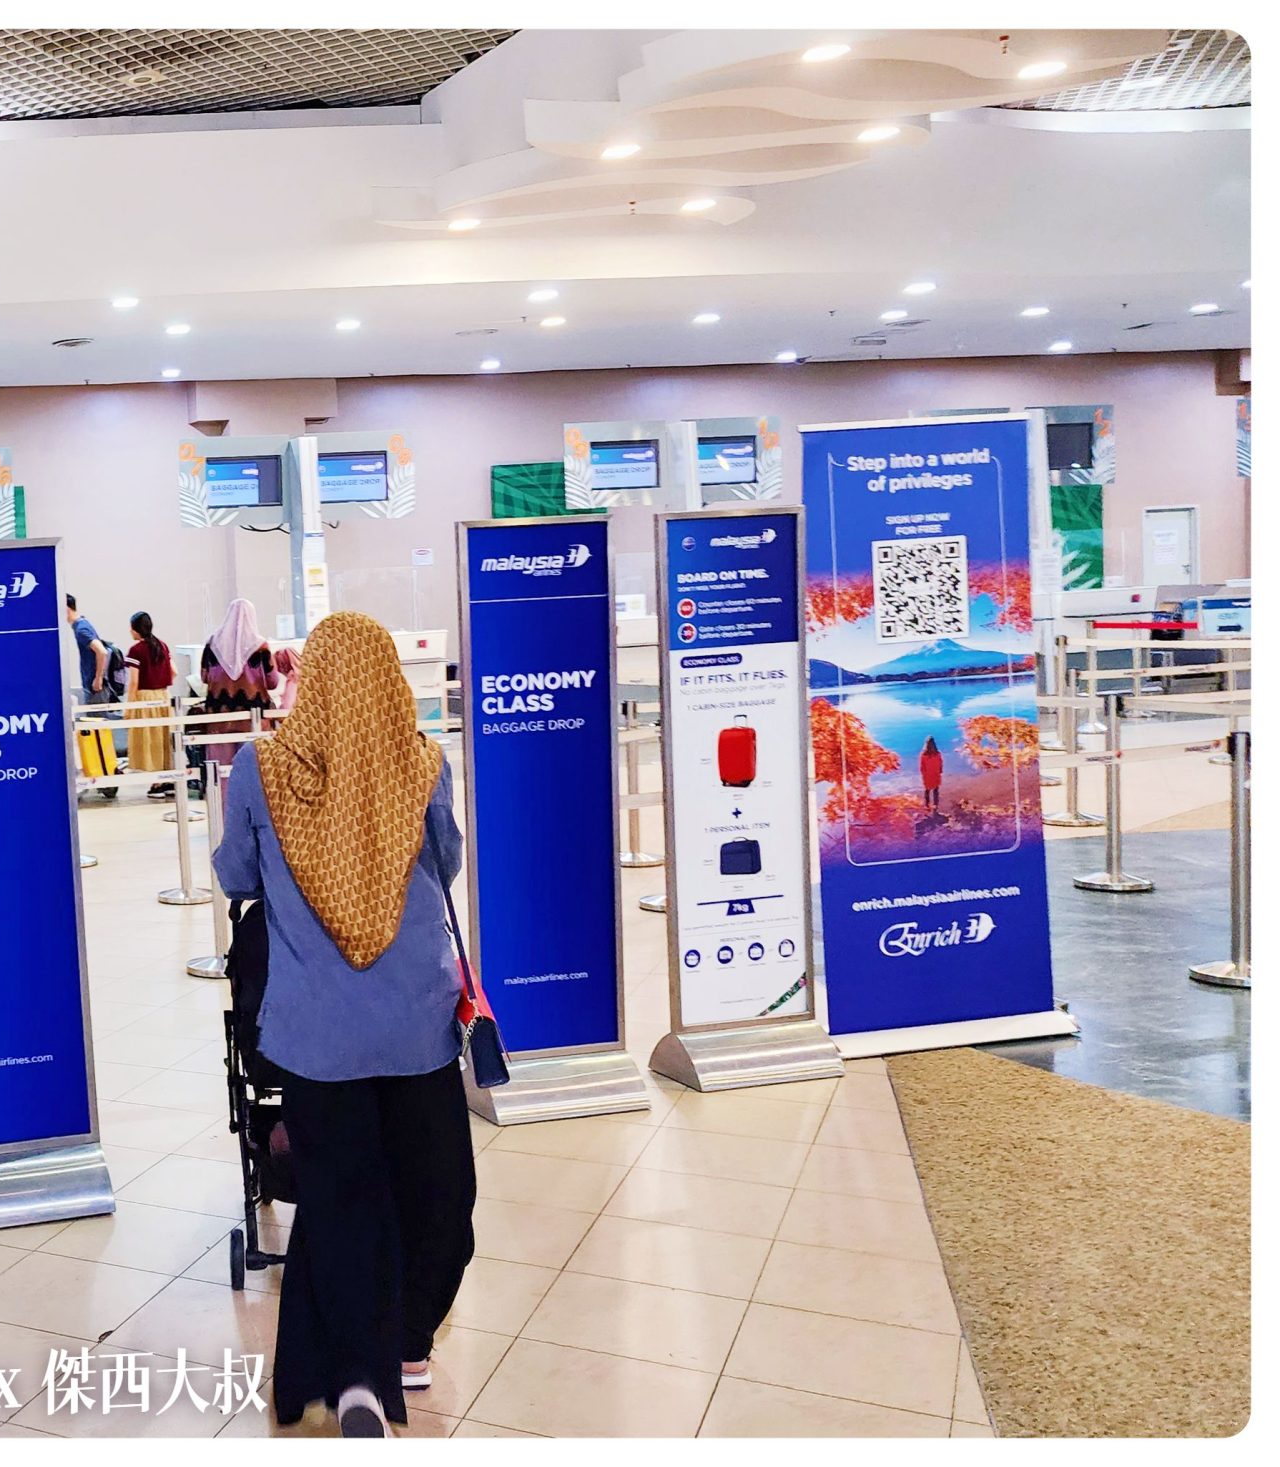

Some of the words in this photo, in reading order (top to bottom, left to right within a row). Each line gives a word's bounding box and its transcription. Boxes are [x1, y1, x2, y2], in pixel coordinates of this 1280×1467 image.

[847, 455, 887, 473] Step
[889, 453, 925, 470] into
[927, 455, 938, 467] a
[941, 448, 991, 466] world
[867, 475, 886, 492] of
[889, 472, 973, 494] privileges
[480, 555, 565, 575] malaysia
[677, 571, 718, 584] BOARD
[719, 570, 737, 581] ON
[481, 670, 596, 694] ECONOMY
[680, 676, 690, 686] IF
[694, 675, 704, 686] IT
[739, 672, 750, 682] IT
[481, 694, 555, 715] CLASS
[482, 719, 545, 735] BAGGAGE
[548, 718, 586, 731] DROP
[852, 885, 1020, 911] enrich.malaysiaairlines.com
[878, 921, 962, 957] Enrich
[503, 971, 589, 986] malaysiaairlines.com
